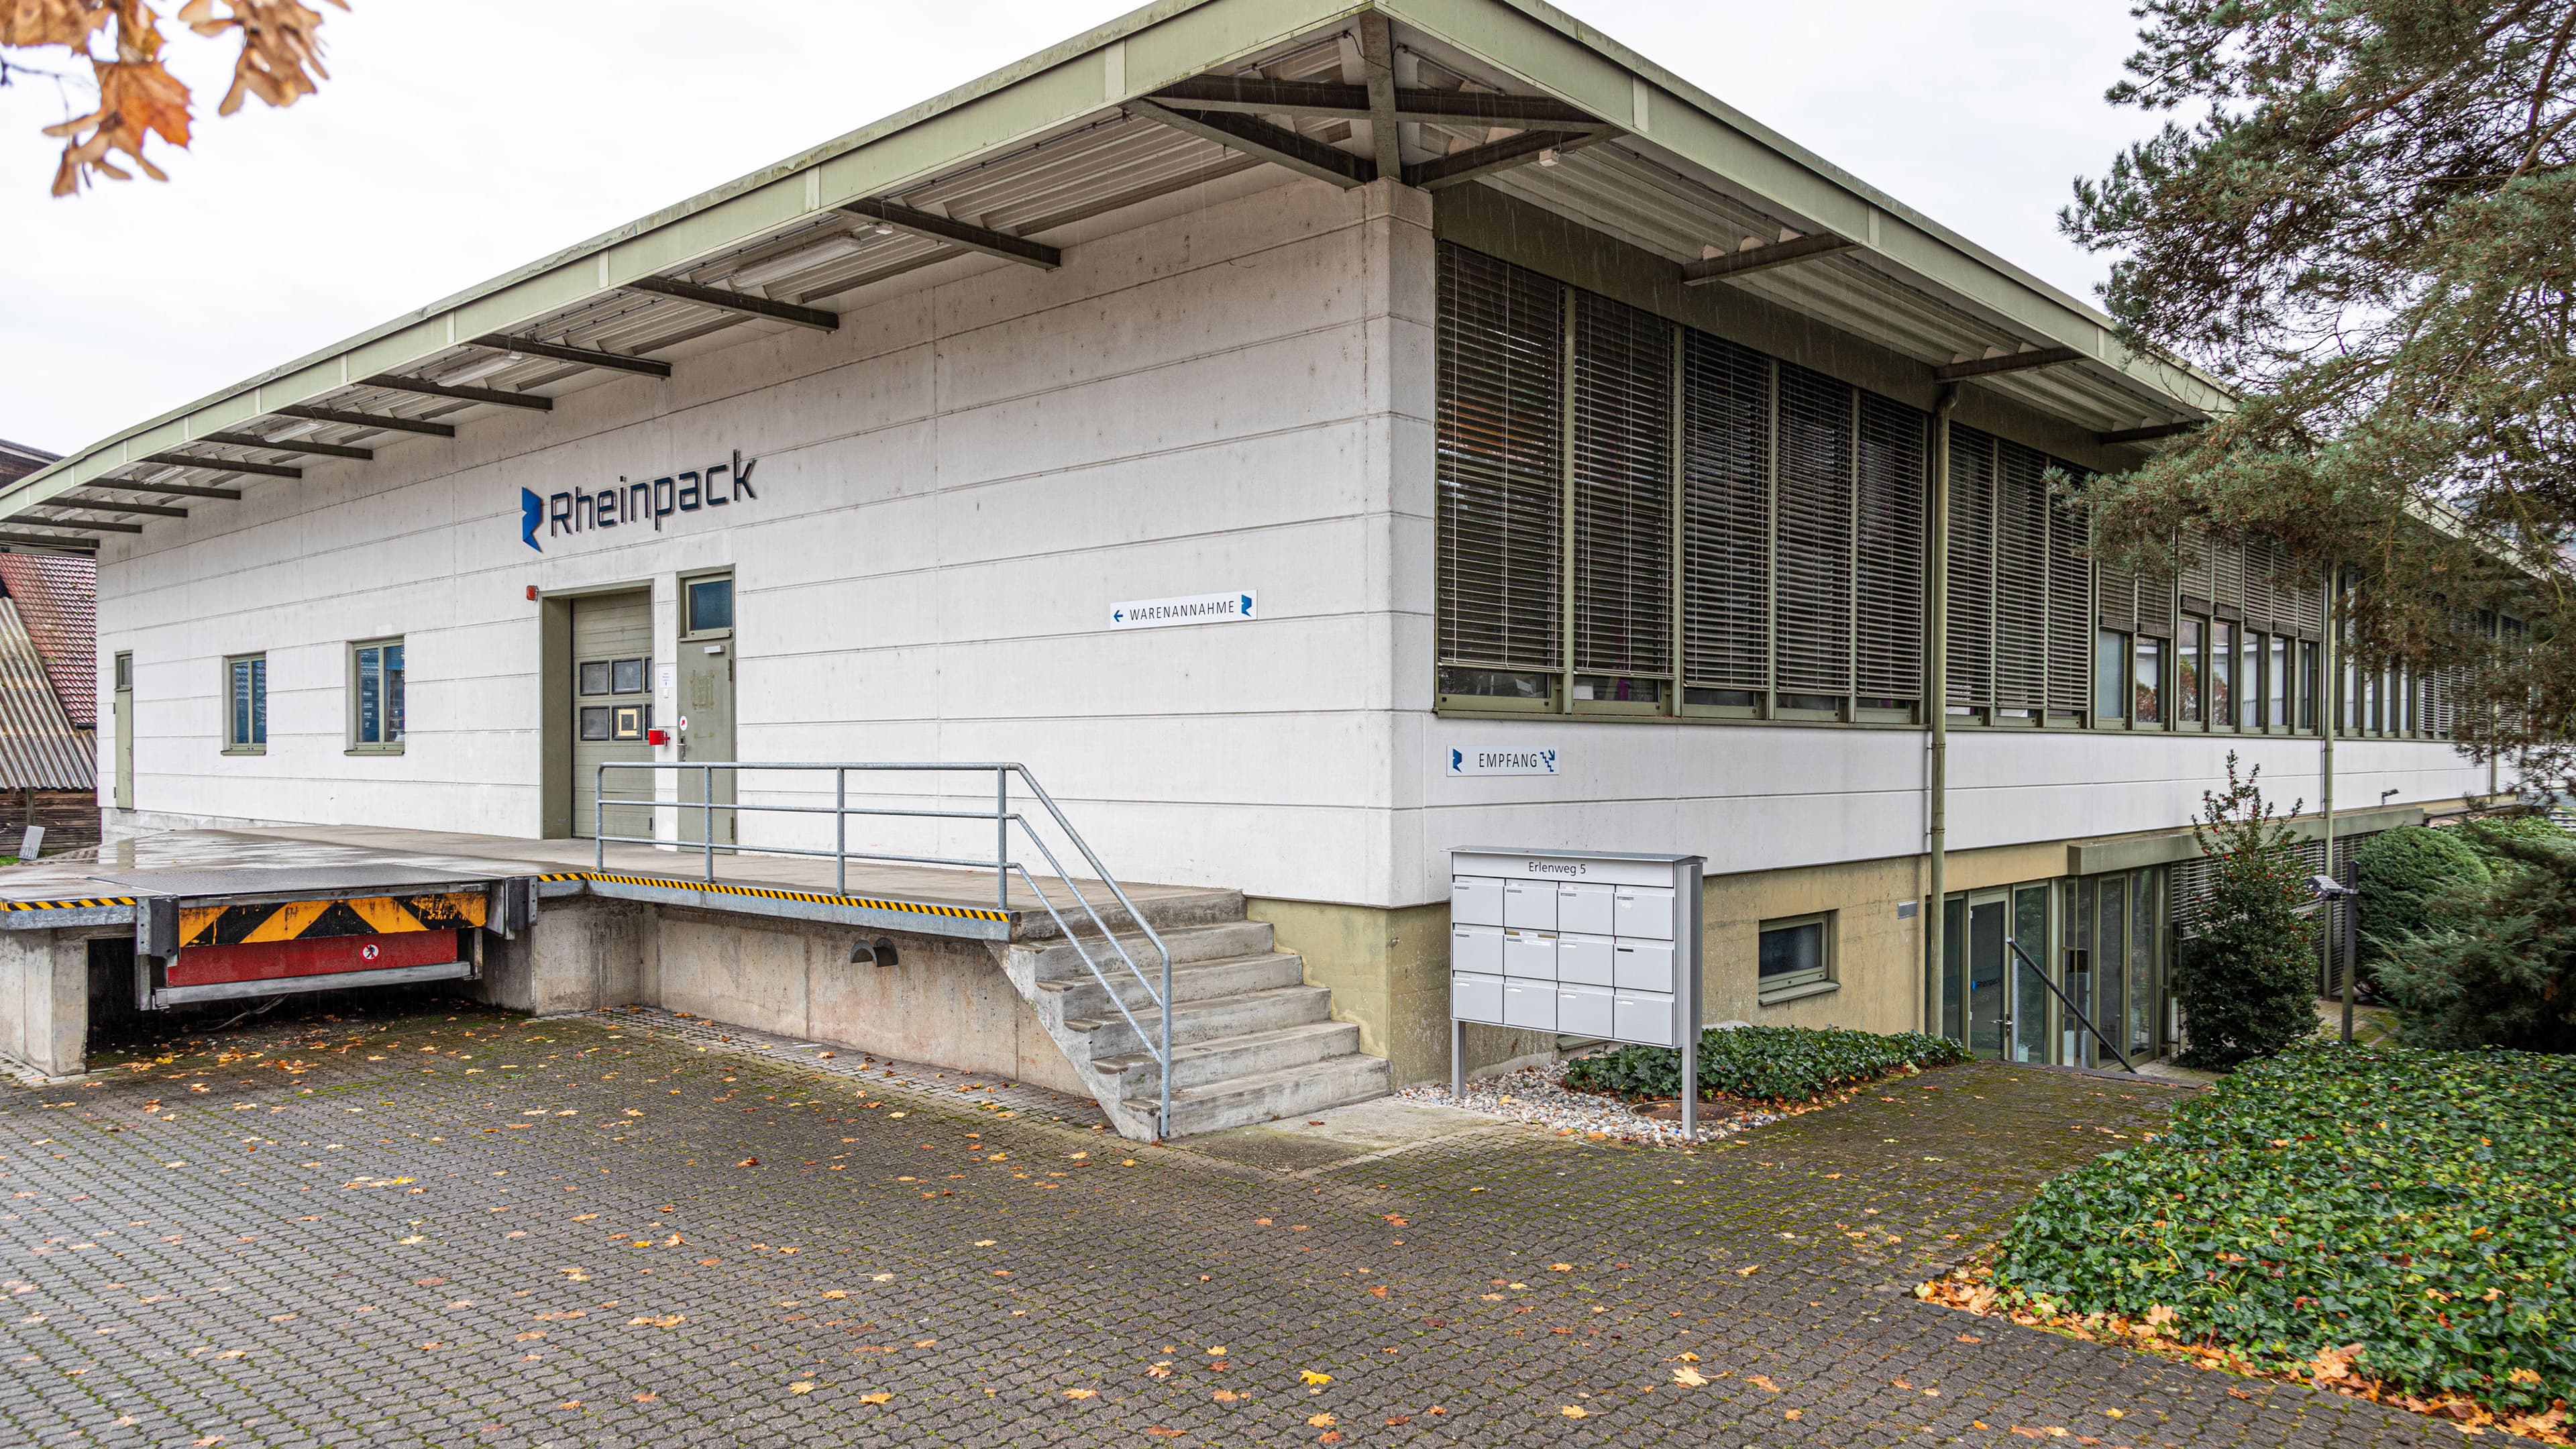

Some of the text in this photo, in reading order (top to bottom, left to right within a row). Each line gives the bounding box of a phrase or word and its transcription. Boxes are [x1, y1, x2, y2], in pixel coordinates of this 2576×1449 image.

[550, 448, 757, 537] Rheinpack
[1129, 600, 1235, 621] WARENANNAHME
[1479, 753, 1538, 768] EMPFANG
[1529, 861, 1587, 877] Erlenweg 5
